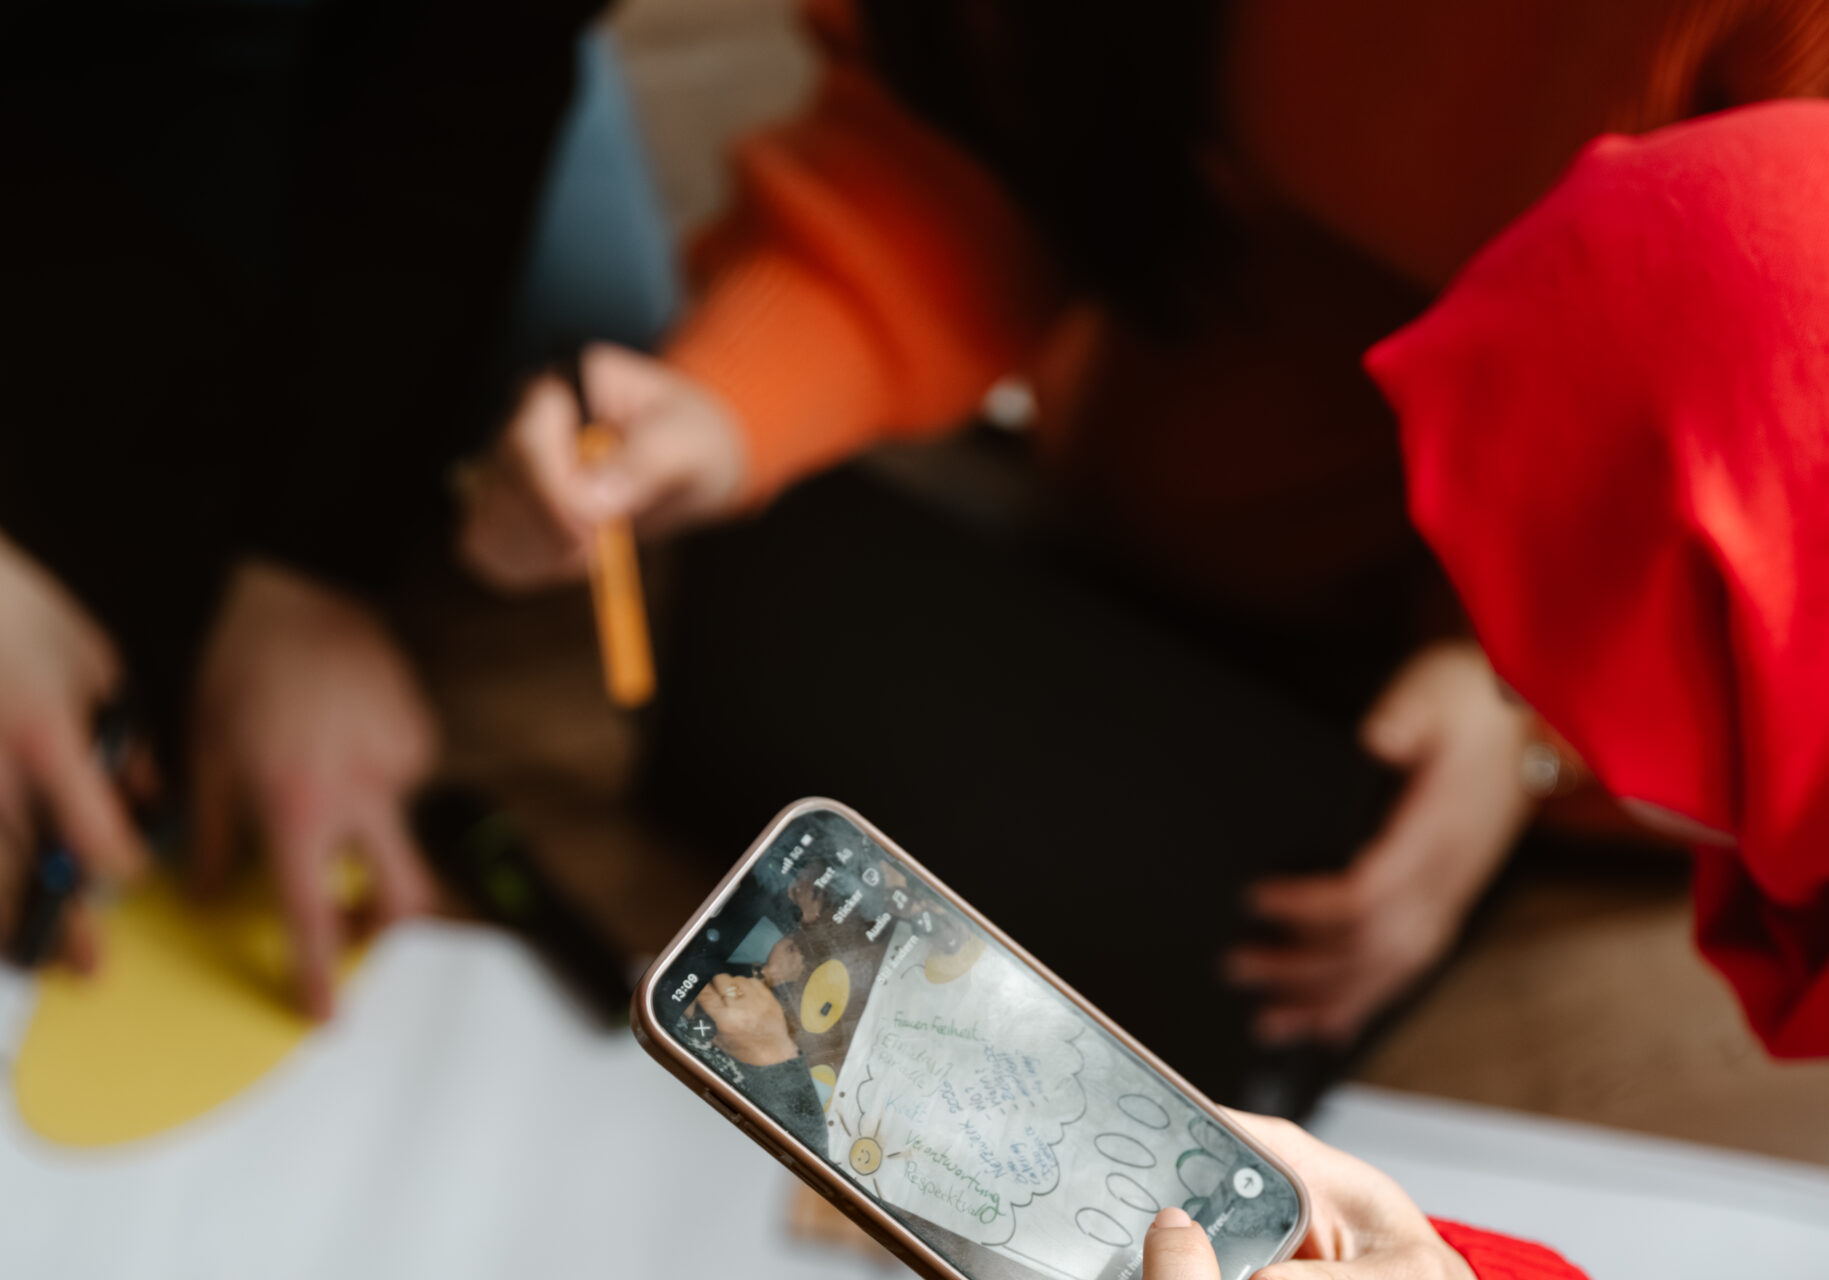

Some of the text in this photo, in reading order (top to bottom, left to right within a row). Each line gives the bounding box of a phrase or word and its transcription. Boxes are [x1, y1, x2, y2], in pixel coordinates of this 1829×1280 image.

[813, 864, 836, 889] Text
[831, 889, 865, 924] Sticker
[864, 911, 892, 941] Audio
[670, 972, 700, 1003] 13:09
